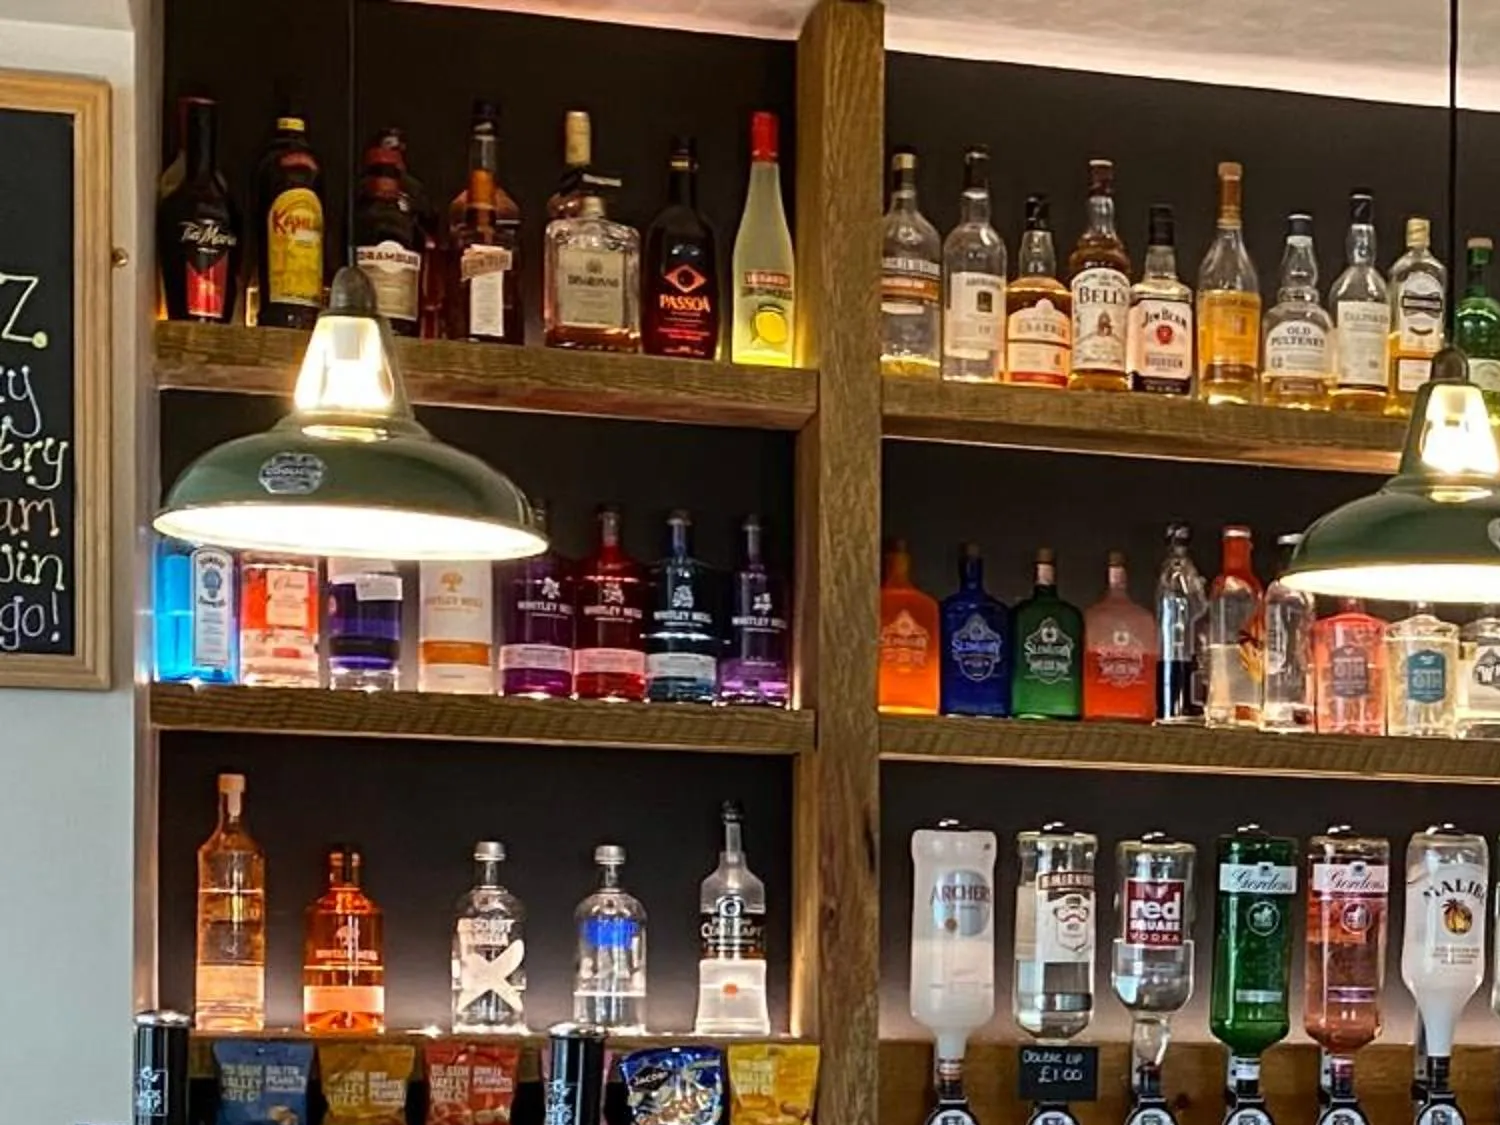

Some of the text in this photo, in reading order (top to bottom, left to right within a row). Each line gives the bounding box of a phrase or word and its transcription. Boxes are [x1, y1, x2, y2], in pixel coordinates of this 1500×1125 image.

[1286, 325, 1312, 336] OLD
[1130, 893, 1180, 919] red
[1130, 919, 1180, 931] SQUARE
[1130, 932, 1180, 943] VODKA
